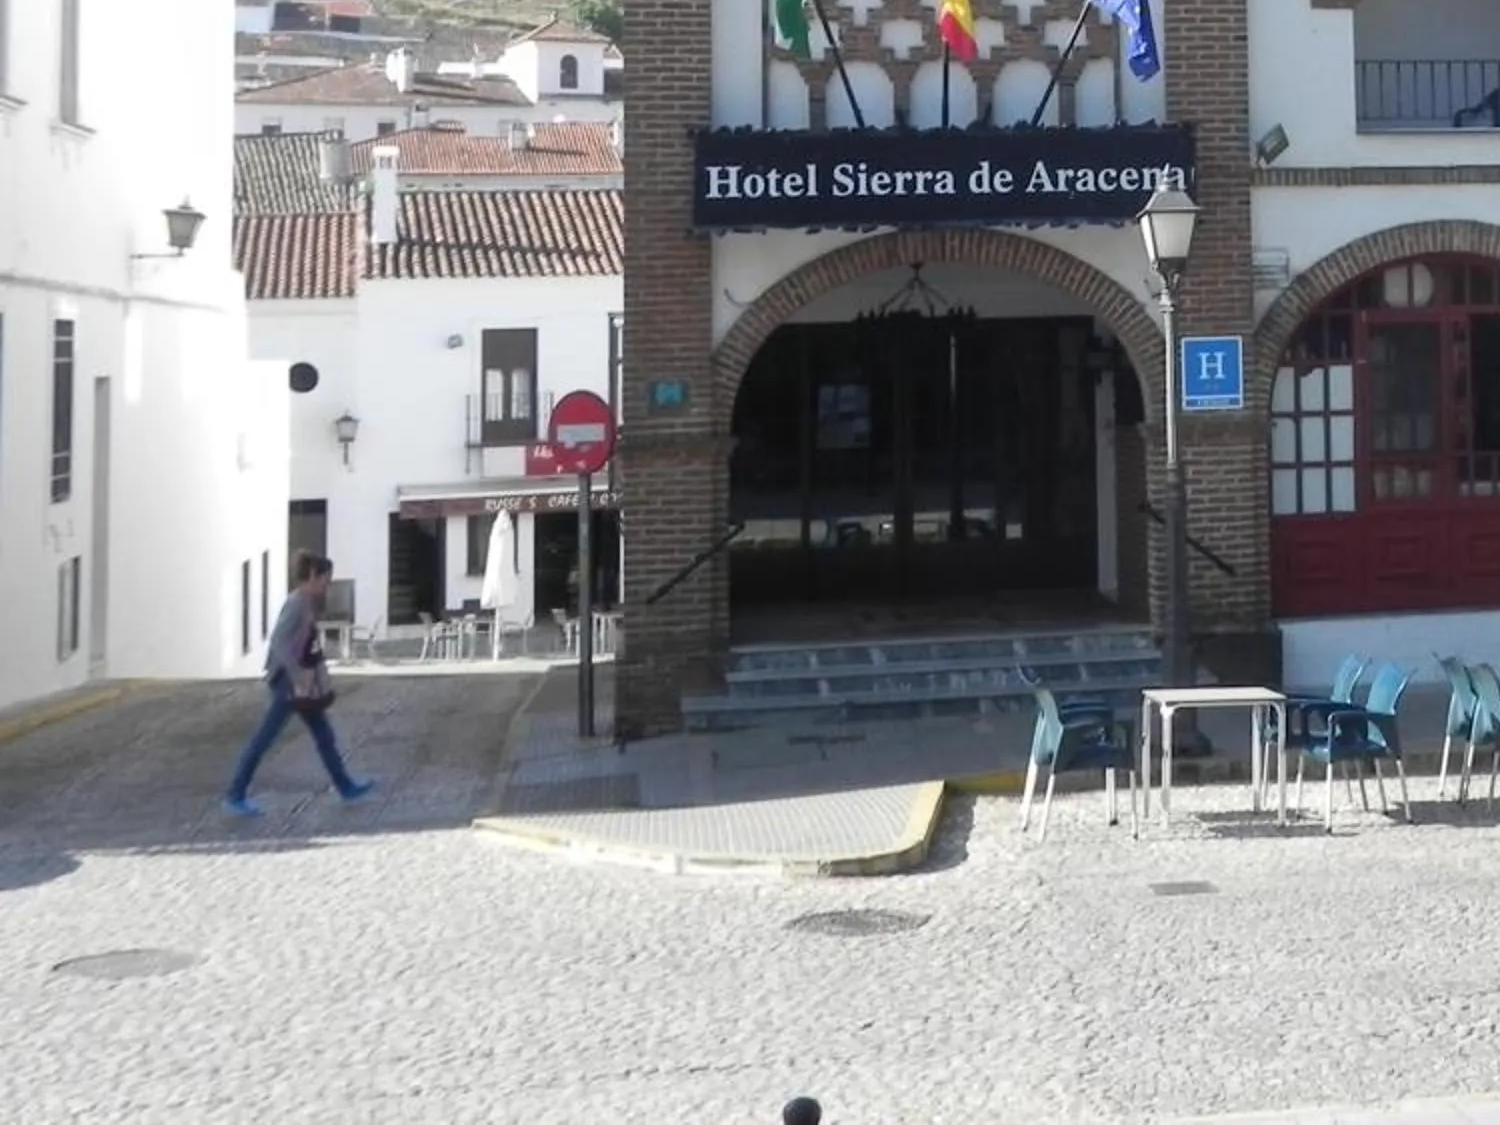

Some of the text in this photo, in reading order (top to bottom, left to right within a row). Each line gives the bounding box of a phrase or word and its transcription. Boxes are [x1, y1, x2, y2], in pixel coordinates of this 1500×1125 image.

[704, 159, 1186, 199] Hotel Sierra de Aracena
[1198, 351, 1226, 380] H
